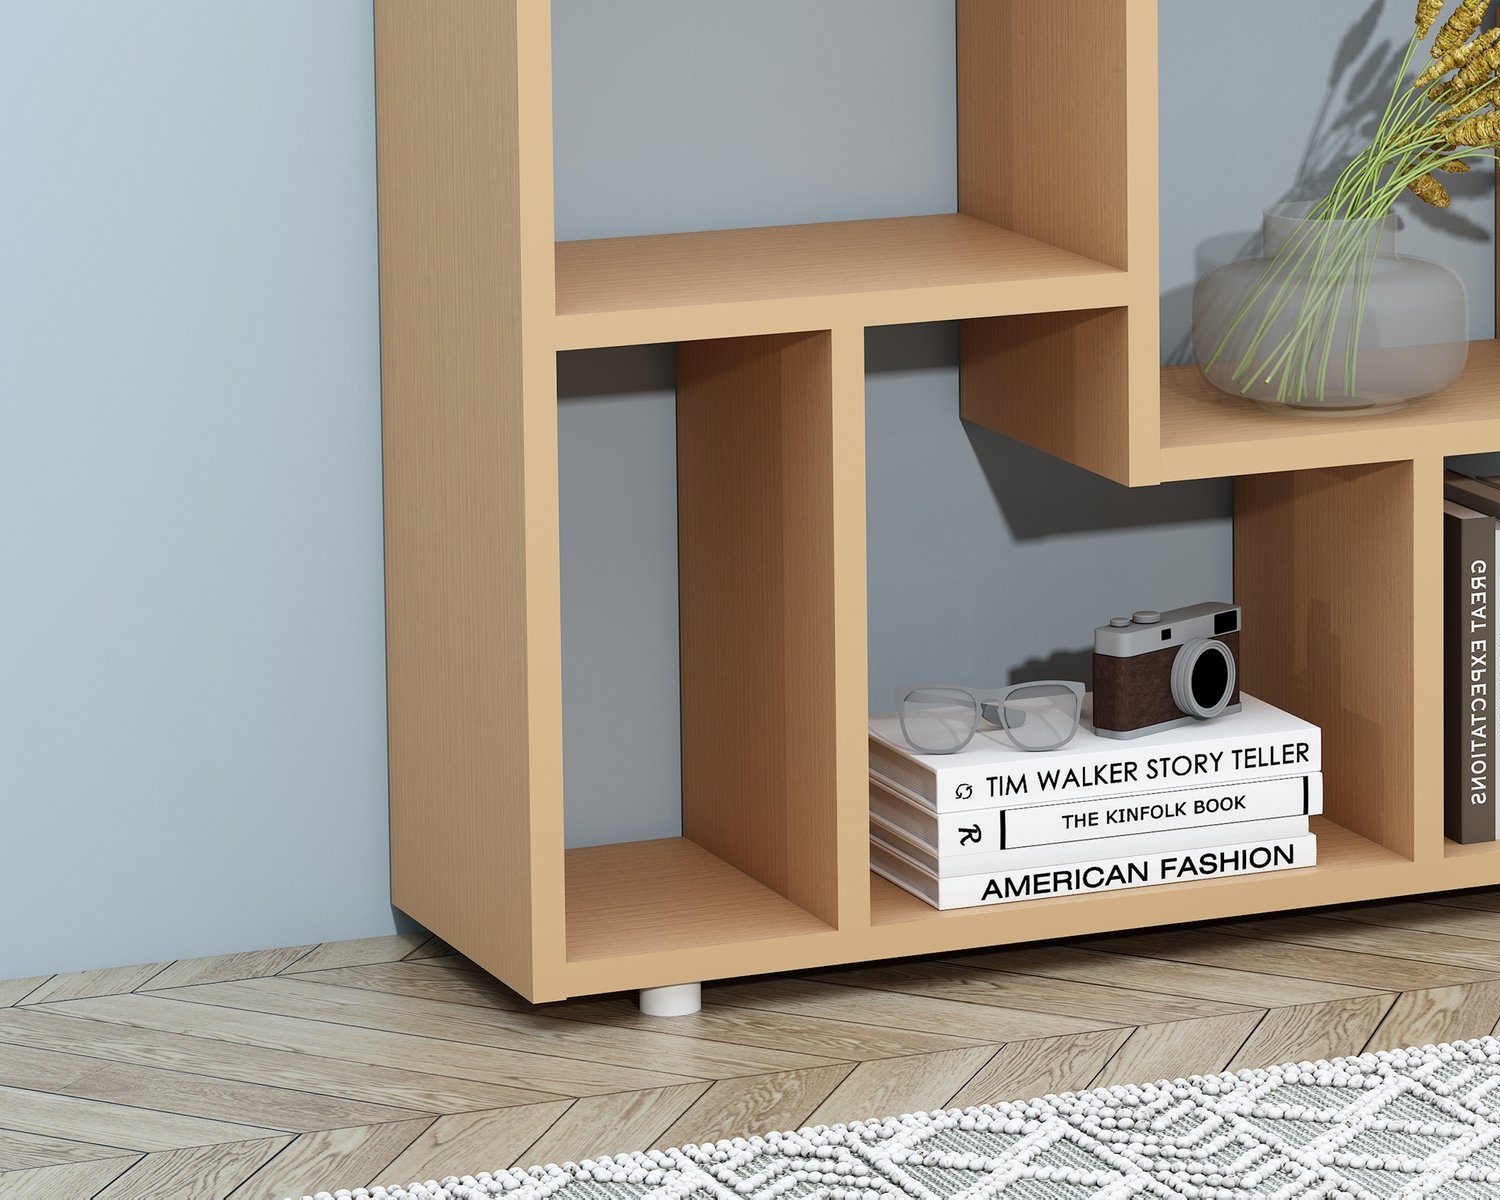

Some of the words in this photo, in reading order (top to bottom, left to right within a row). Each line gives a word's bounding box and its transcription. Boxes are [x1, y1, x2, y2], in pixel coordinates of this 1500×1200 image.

[985, 773, 1028, 798] TIM
[1036, 761, 1138, 792] WALKER
[1146, 751, 1224, 780] STORY
[1231, 742, 1310, 770] TELLER
[1061, 812, 1099, 830] THE
[1106, 801, 1187, 825] KINFOLK
[1193, 794, 1247, 815] BOOK
[980, 861, 1150, 901] AMERICAN
[1160, 843, 1296, 882] FASHION
